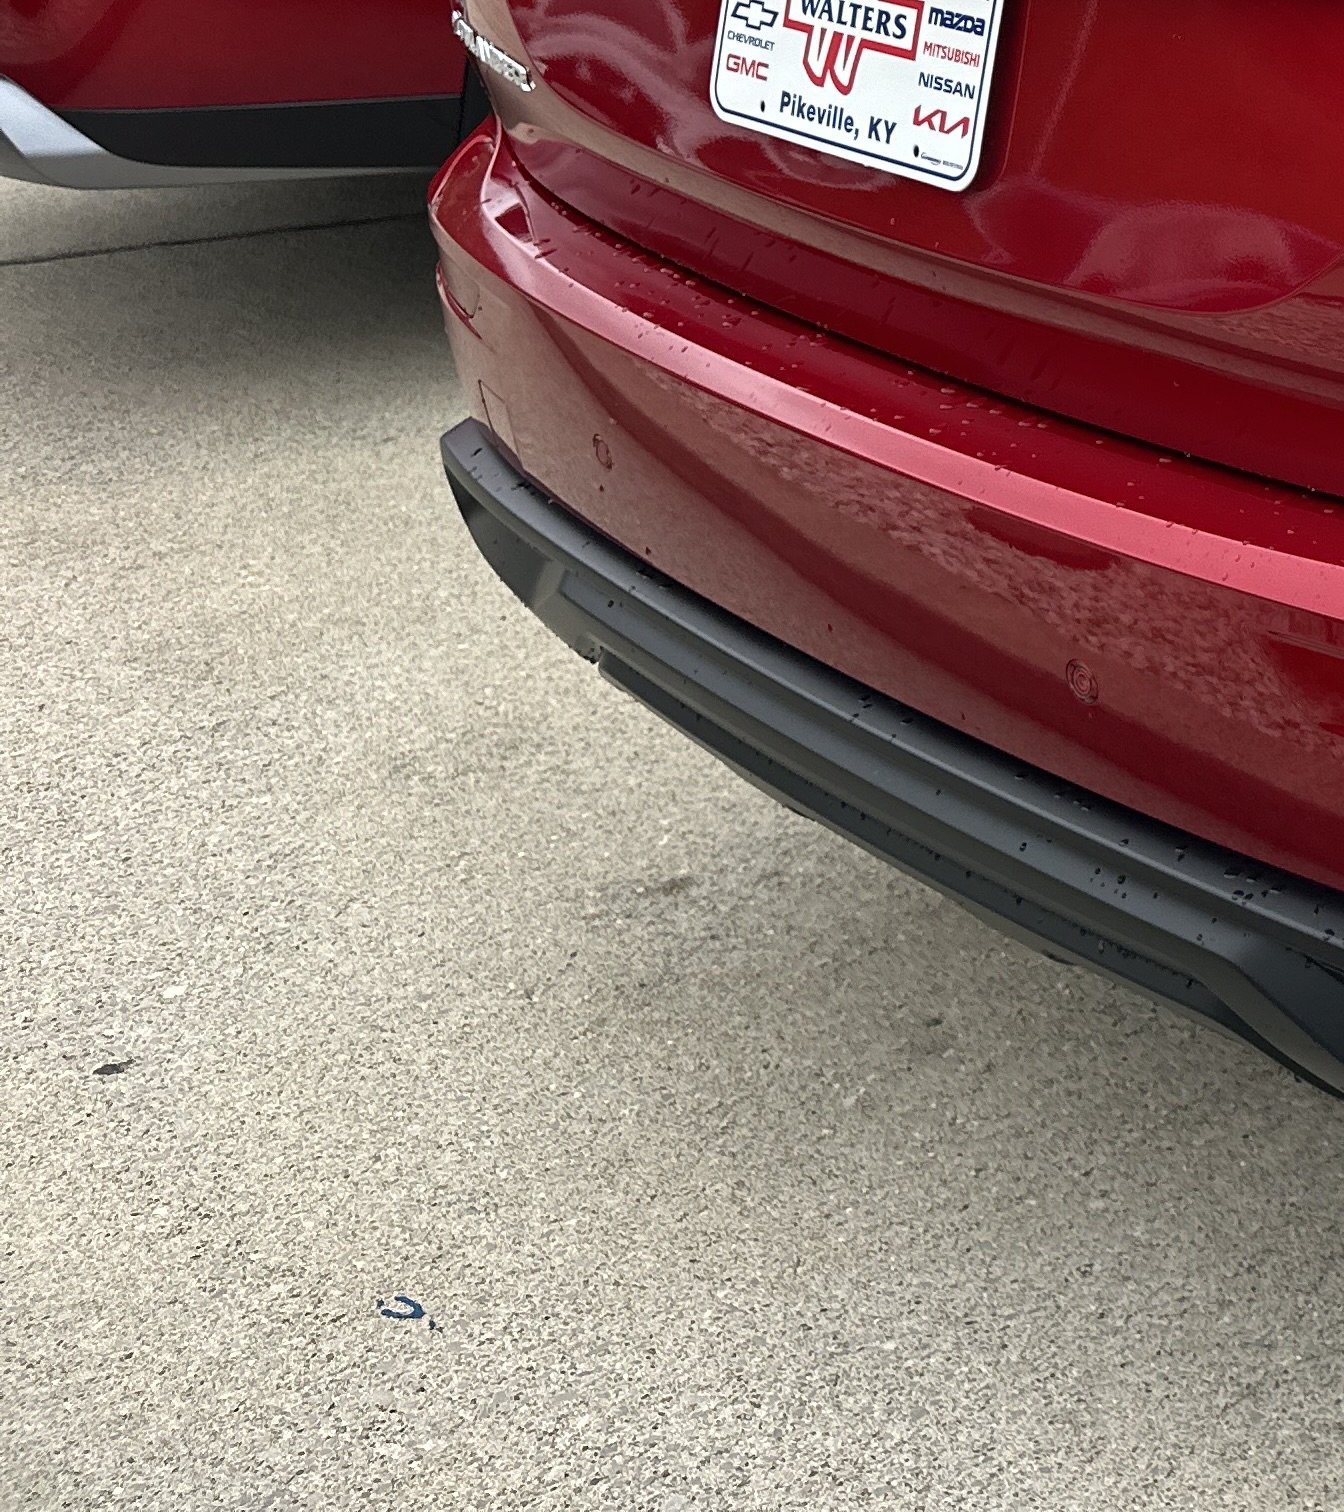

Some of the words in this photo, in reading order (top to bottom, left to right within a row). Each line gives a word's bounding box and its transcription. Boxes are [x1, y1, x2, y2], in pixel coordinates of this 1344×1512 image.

[727, 30, 776, 52] CHEVROLET
[923, 41, 981, 68] MITSUBISHI
[726, 53, 770, 82] GMC
[918, 71, 976, 100] NISSAN
[779, 90, 860, 141] Pikeville,
[867, 115, 897, 145] KY
